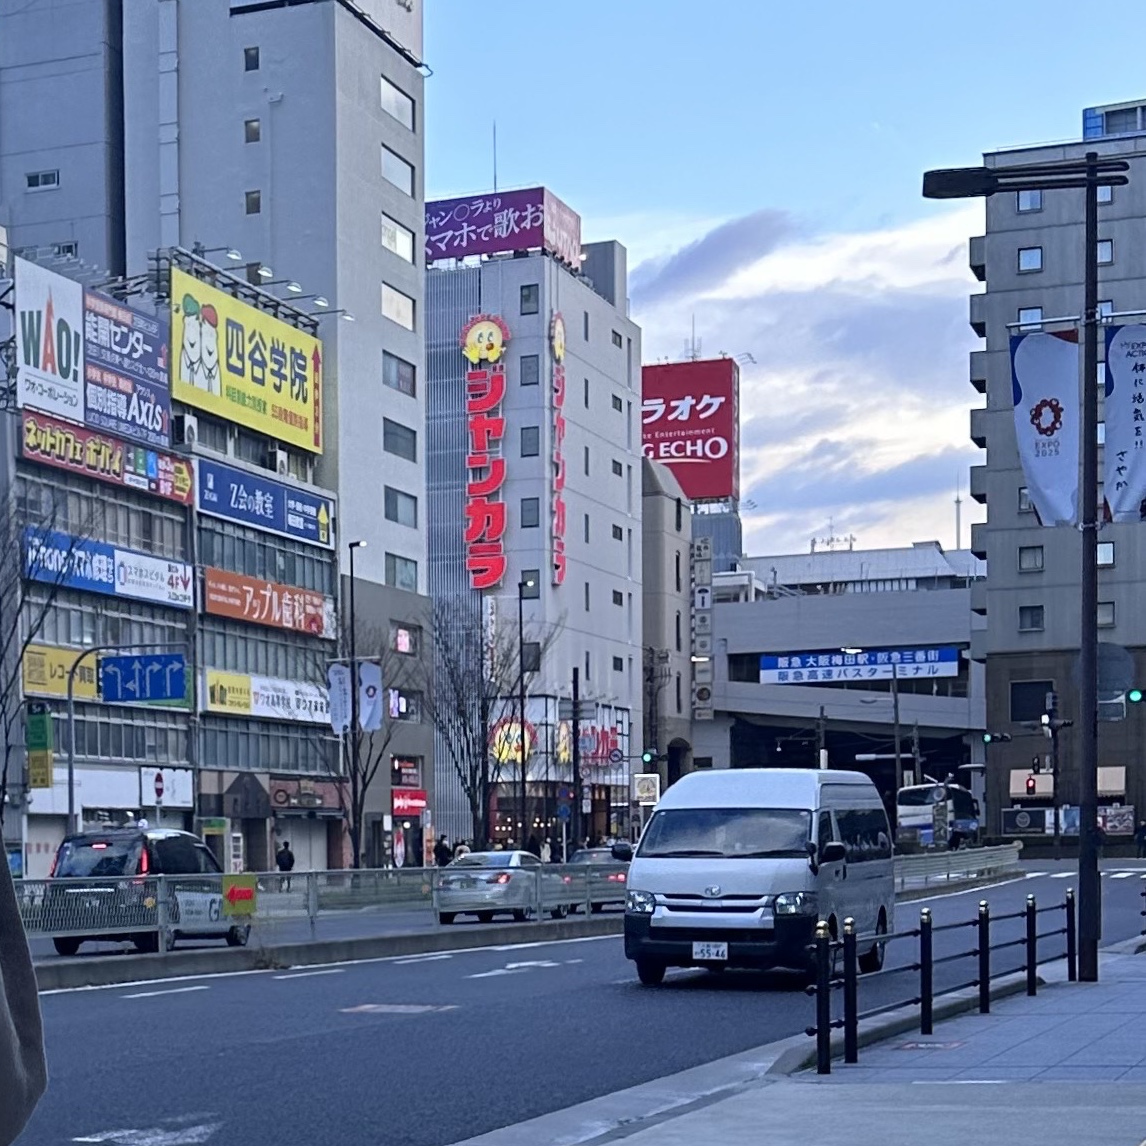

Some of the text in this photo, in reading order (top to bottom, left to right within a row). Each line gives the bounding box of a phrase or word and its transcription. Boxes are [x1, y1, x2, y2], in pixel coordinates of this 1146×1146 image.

[20, 284, 81, 383] WAO!
[85, 310, 153, 359] 能開センター
[225, 317, 308, 404] 四谷学院
[25, 419, 84, 462] ネットカフェ
[655, 427, 716, 439] Entertainment
[659, 436, 729, 460] ECHO
[1035, 442, 1060, 450] EXPO
[1034, 449, 1060, 458] 2025
[230, 482, 274, 519] Z会の教室
[242, 583, 306, 630] アップル歯科
[777, 650, 940, 668] 阪急 大阪梅田駅・阪急三番街
[777, 664, 939, 682] 阪急高速バスターミナル
